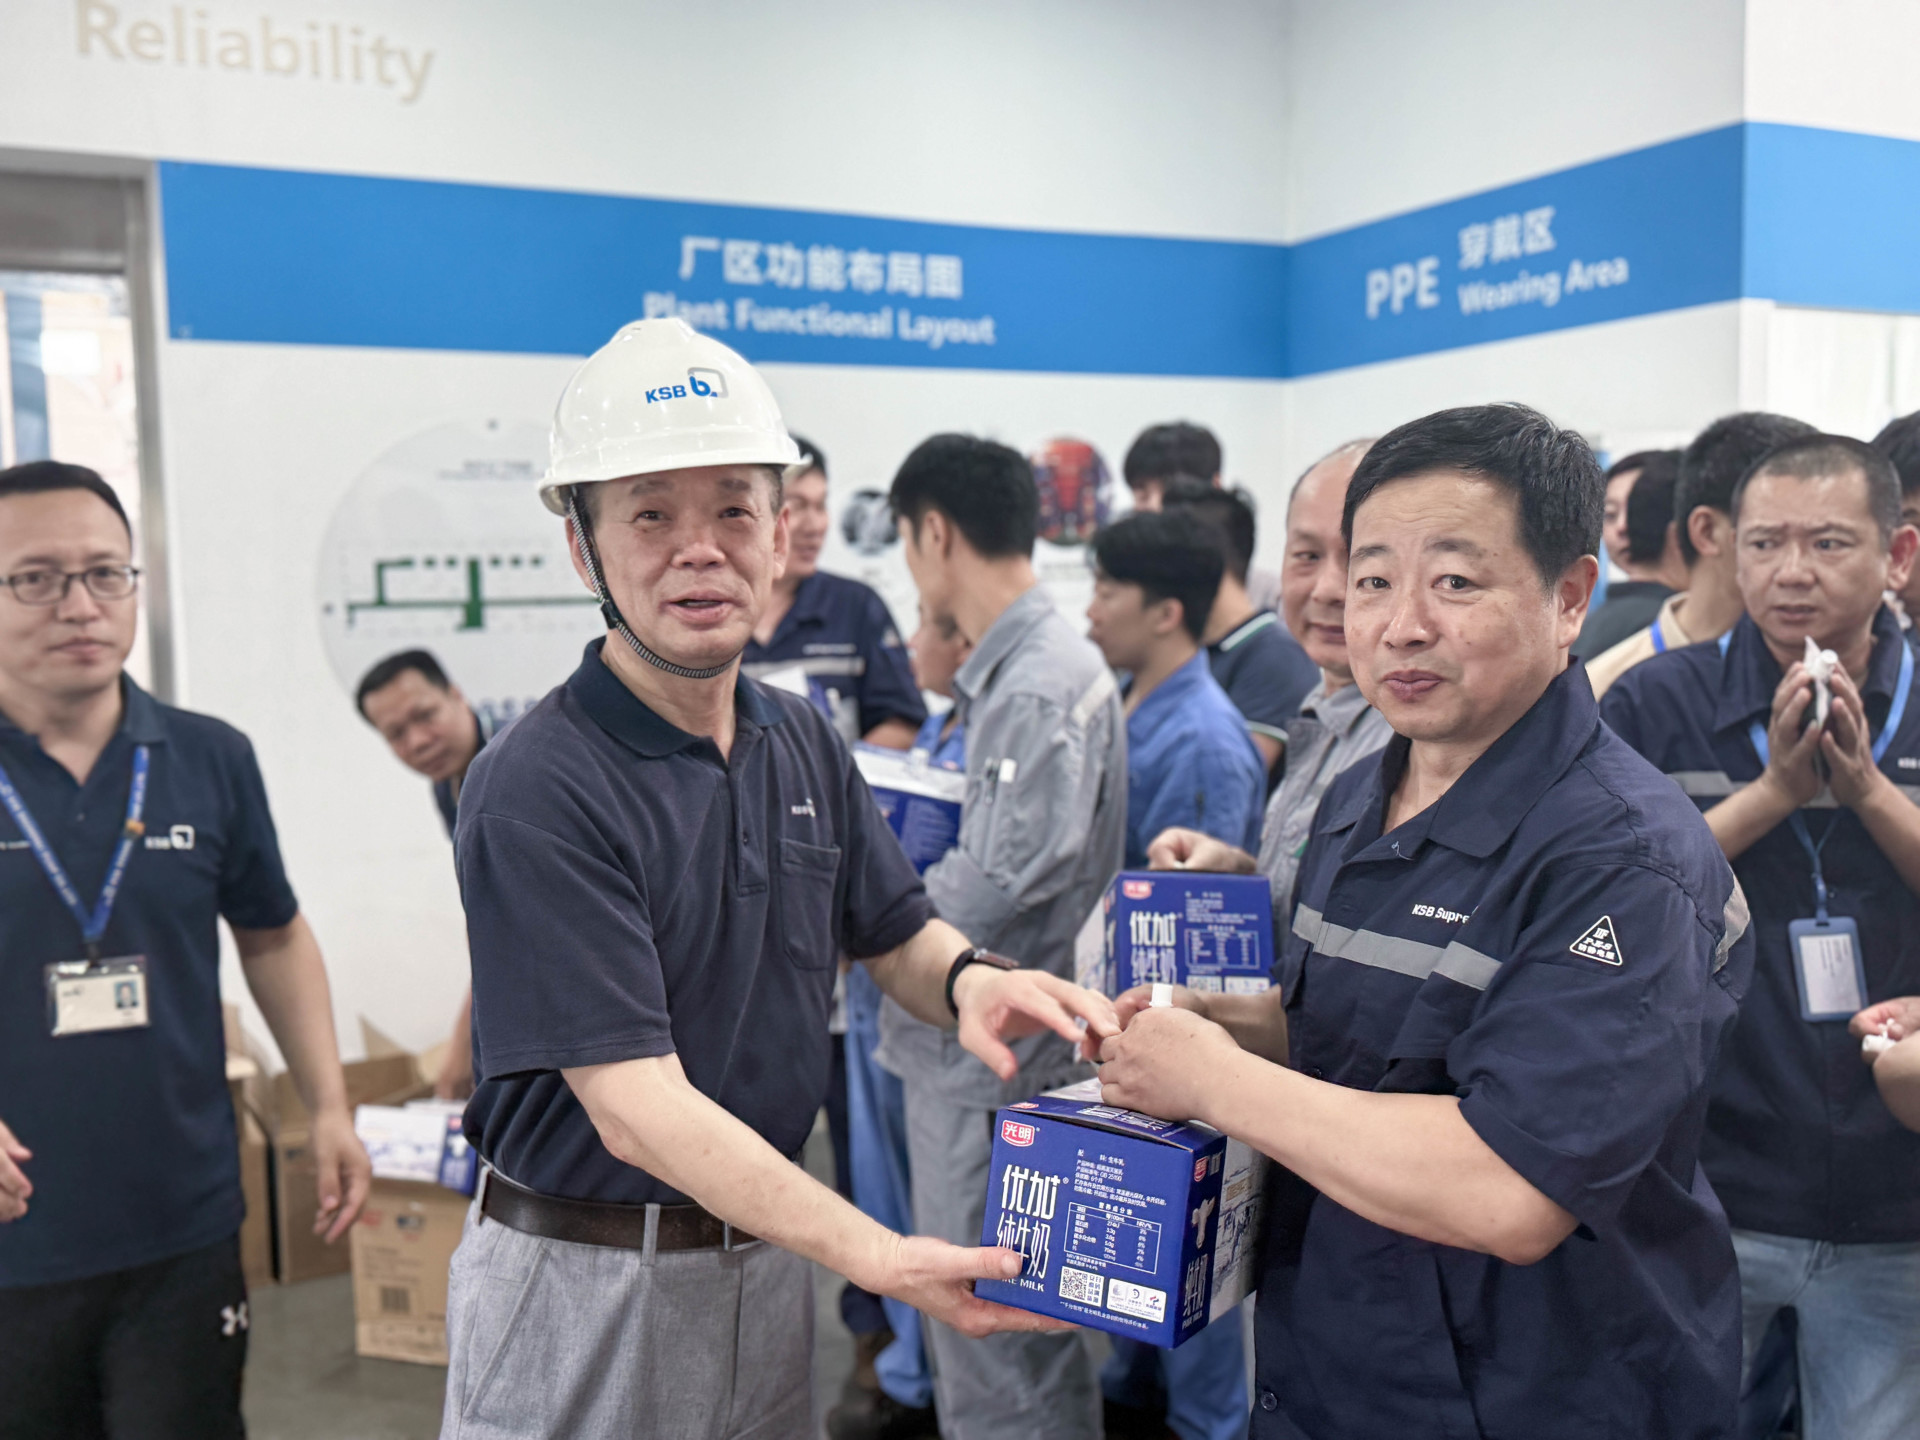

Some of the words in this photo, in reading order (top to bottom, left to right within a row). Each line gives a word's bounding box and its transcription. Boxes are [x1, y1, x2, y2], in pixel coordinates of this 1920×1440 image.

[76, 0, 434, 104] Reliability
[1458, 205, 1556, 270] 穿戴区
[679, 236, 964, 299] 厂区功能布局图
[1366, 256, 1440, 319] PPE
[1458, 270, 1561, 316] Wearing
[1565, 257, 1629, 294] Area
[643, 291, 729, 330] Plant
[734, 297, 893, 340] Functional
[897, 307, 996, 350] Layout
[645, 385, 687, 404] KSB
[1411, 904, 1435, 917] KSB
[1004, 1123, 1033, 1140] 光明
[1002, 1164, 1061, 1220] 优加
[997, 1211, 1050, 1279] 纯牛奶
[1020, 1278, 1044, 1292] MILK
